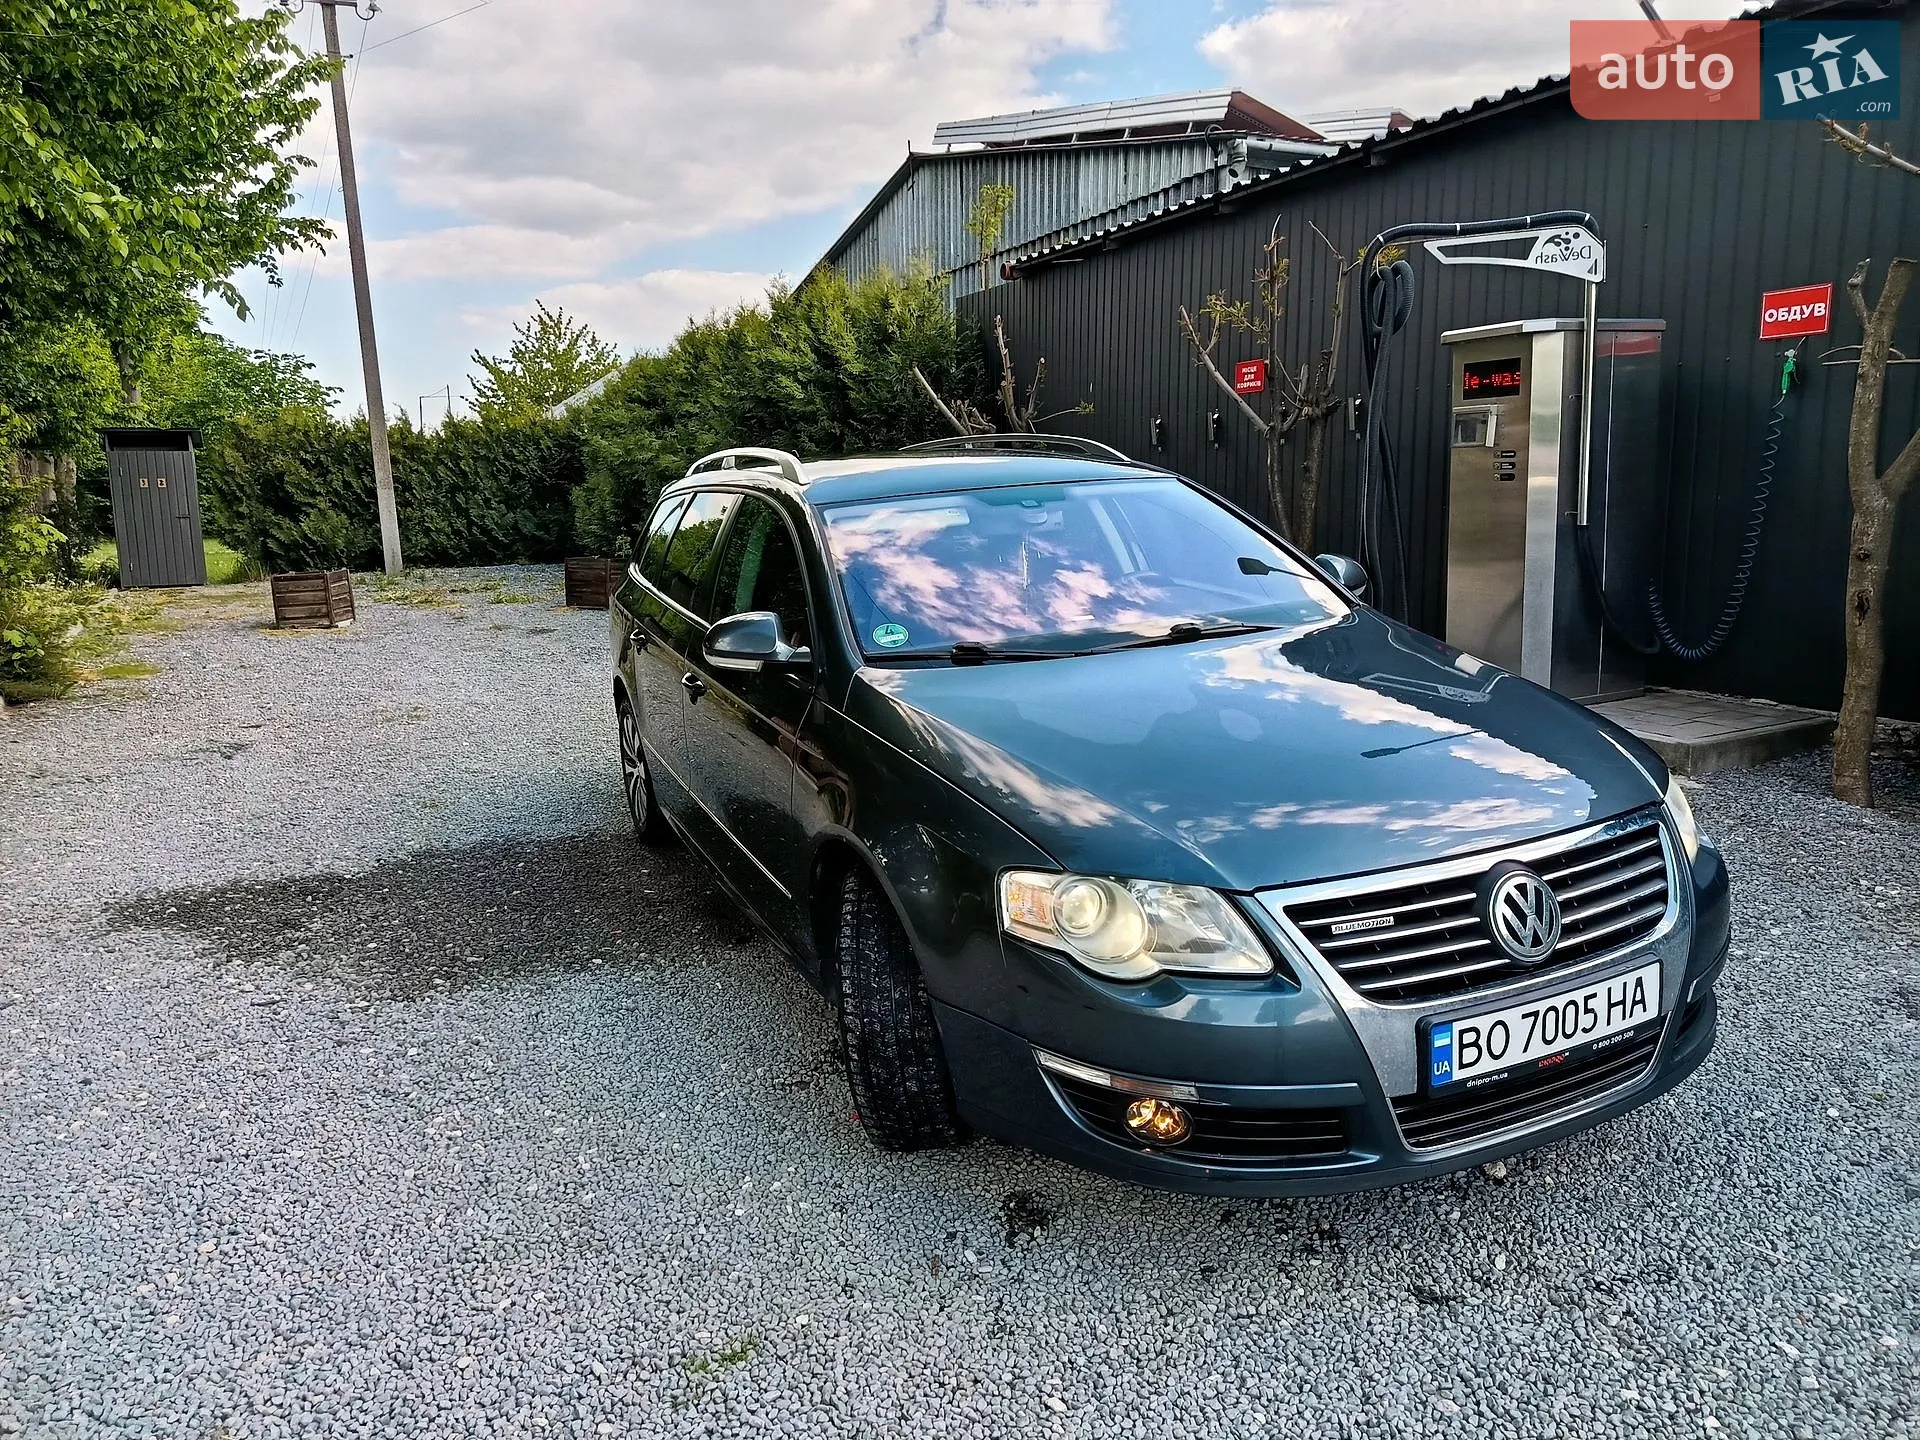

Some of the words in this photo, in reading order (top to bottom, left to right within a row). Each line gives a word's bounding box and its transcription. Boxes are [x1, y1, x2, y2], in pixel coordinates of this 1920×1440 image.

[1765, 302, 1826, 323] ОБДУВ
[1333, 917, 1393, 933] BLUEMOTION
[1458, 1019, 1510, 1071] BO
[1521, 992, 1598, 1054] 7005
[1606, 976, 1647, 1027] HA
[1434, 1060, 1451, 1075] UA
[1466, 1072, 1509, 1088] dnipro-m.ua
